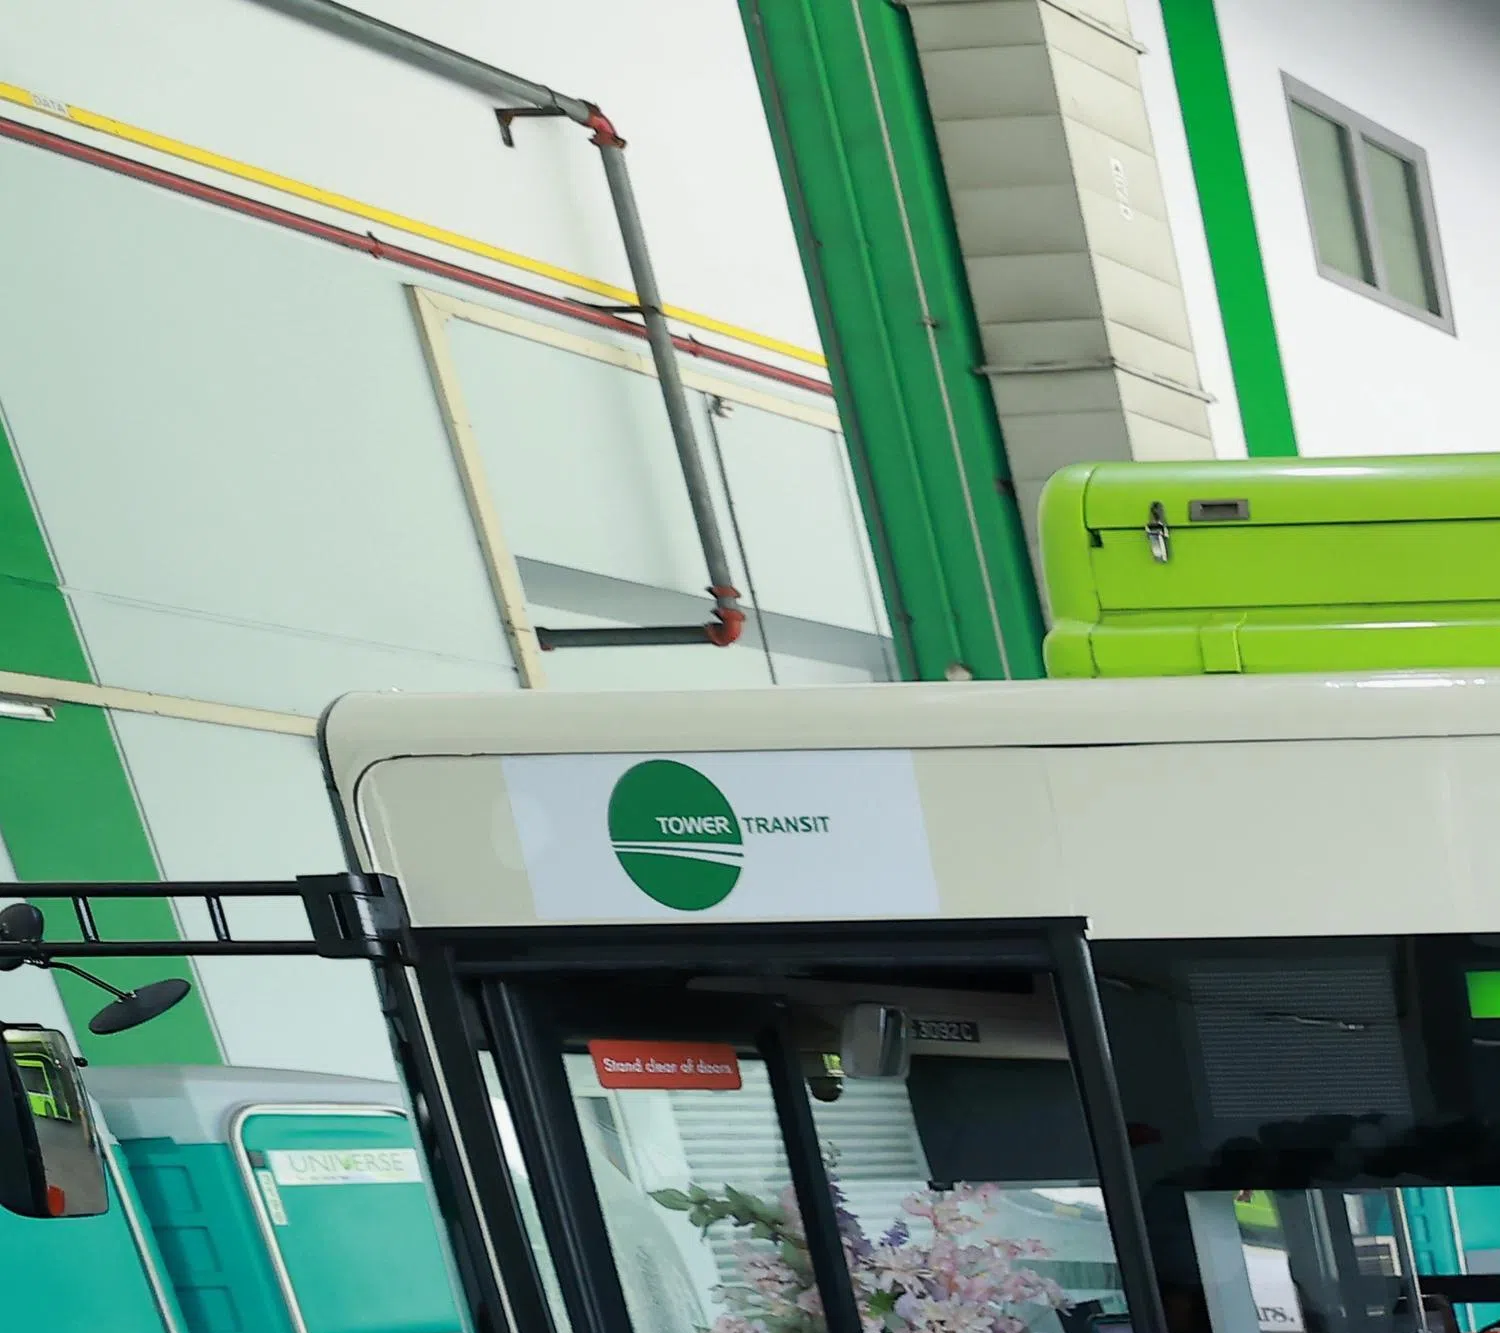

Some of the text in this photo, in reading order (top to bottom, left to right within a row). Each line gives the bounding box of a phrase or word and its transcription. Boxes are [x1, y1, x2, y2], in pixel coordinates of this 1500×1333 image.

[656, 816, 830, 835] TOWER TRANSIT
[603, 1057, 643, 1073] Stand
[645, 1057, 678, 1073] clear
[680, 1058, 694, 1073] of
